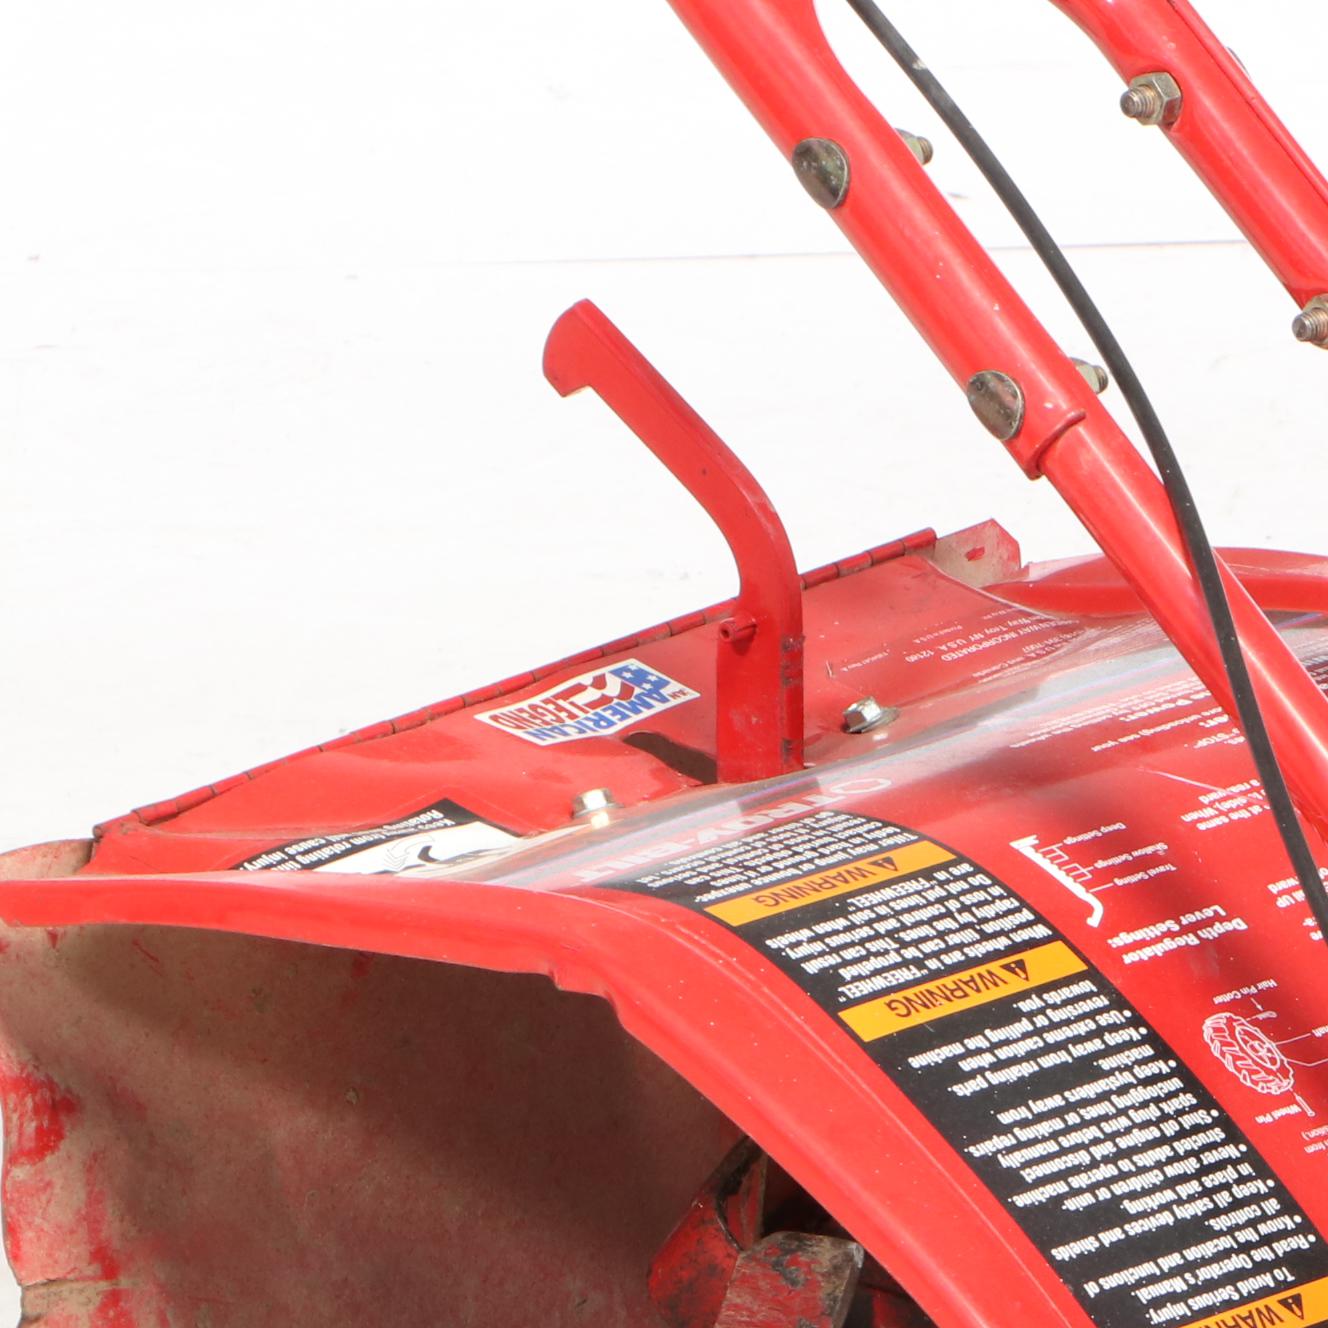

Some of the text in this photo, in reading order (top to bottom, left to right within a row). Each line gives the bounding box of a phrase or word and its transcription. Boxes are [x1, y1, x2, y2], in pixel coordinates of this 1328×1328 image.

[488, 696, 590, 731] LEGEND
[523, 688, 671, 740] AMERICAN
[574, 793, 847, 883] TROY-BILT
[948, 862, 974, 876] are
[752, 865, 877, 907] WARNING
[932, 870, 953, 881] in
[764, 873, 992, 949] Do not put tines in soil when wheels
[780, 884, 1007, 960] in loss of control and serious injury.
[799, 896, 1020, 974] rapidly by the tines. This can result
[1008, 923, 1052, 942] When
[1106, 904, 1226, 948] Lever Settings:
[1121, 917, 1248, 964] Depth Regulator
[837, 907, 1035, 981] position, tiller can be propelled
[923, 957, 945, 970] in
[939, 949, 966, 965] are
[962, 935, 1012, 958] wheels
[883, 968, 1008, 1018] WARNING
[1012, 979, 1098, 1012] towards you.
[907, 994, 1110, 1068] reversing or pulling the machine
[946, 1026, 1141, 1096] Keep away from rotating parts.
[957, 1009, 1126, 1072] Use extreme caution when
[996, 1092, 1197, 1168] spark plug wire before manually
[1019, 1108, 1212, 1183] Shut off engine and disconnect
[1007, 1126, 1226, 1207] structed adults to operate machine.
[1060, 1143, 1241, 1211] Never allow children or unin-
[1050, 1178, 1269, 1261] Keep all safety devices and shields
[1082, 1214, 1296, 1298] Know the location and functions of
[1130, 1233, 1310, 1304] Read the Operator's Manual.
[1144, 1266, 1295, 1325] To Avoid Serious Injury:
